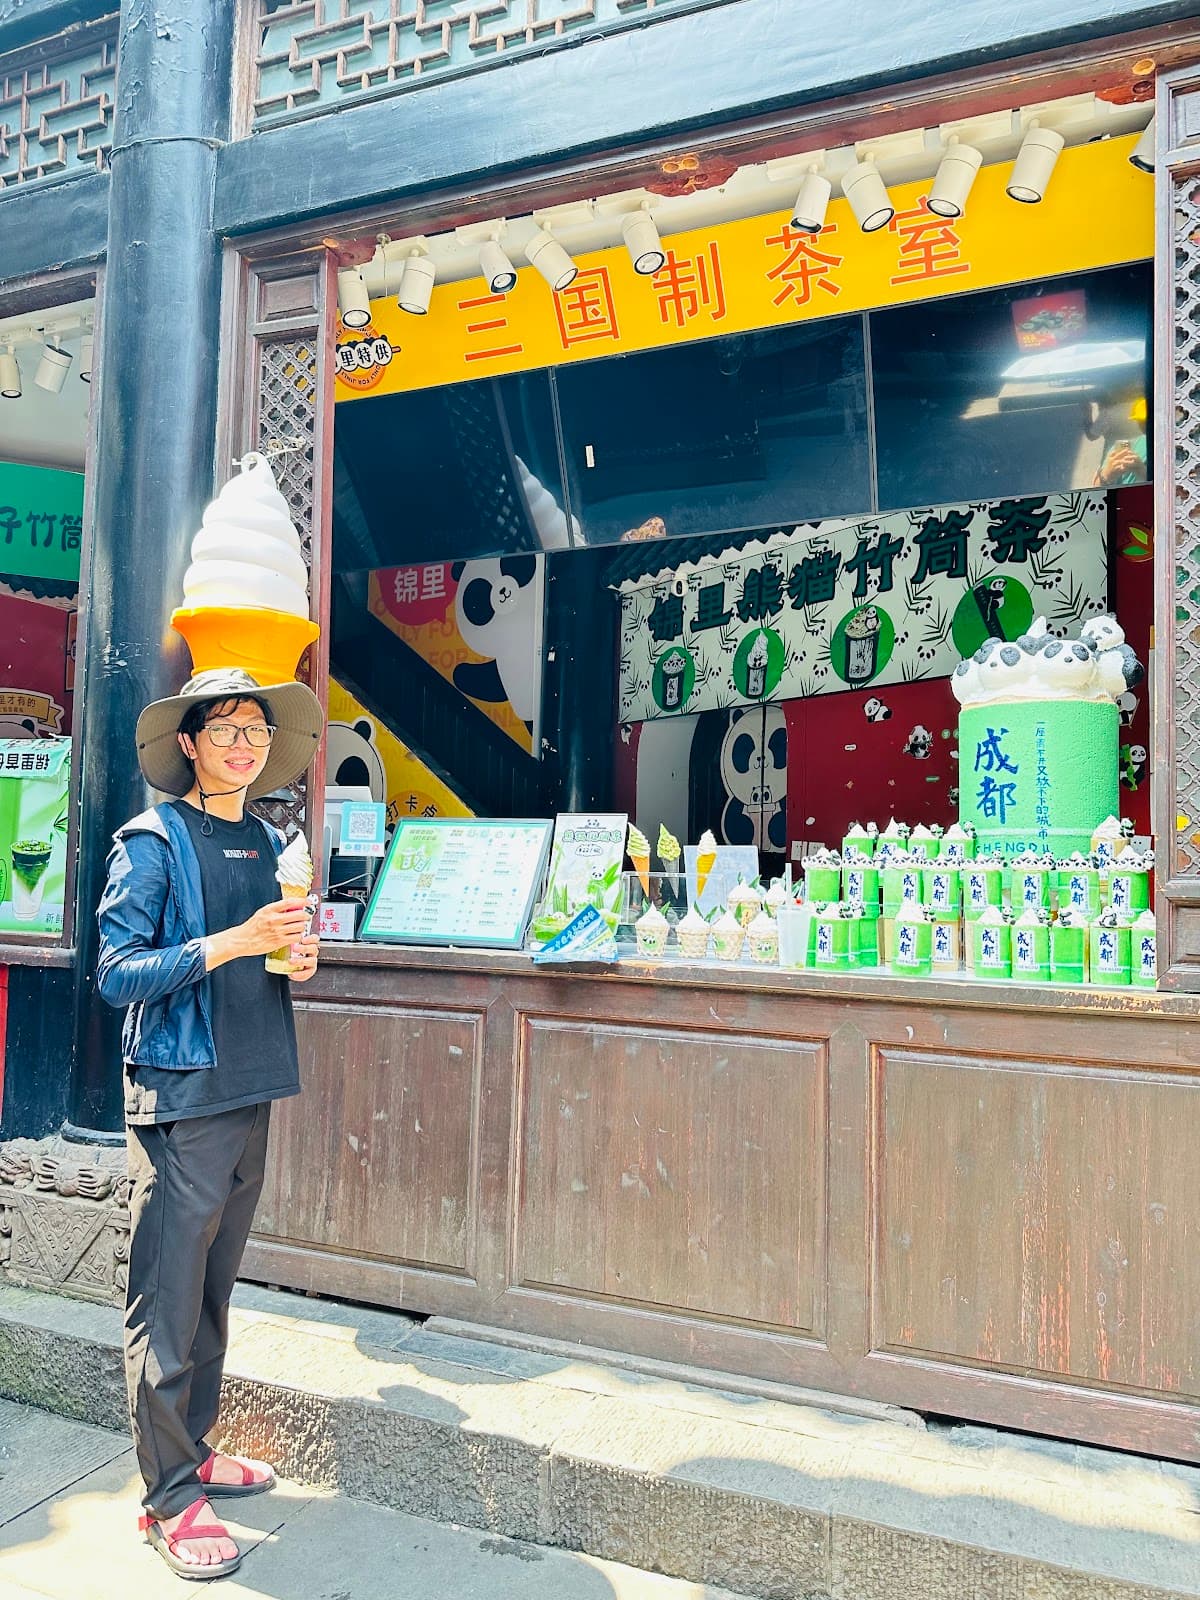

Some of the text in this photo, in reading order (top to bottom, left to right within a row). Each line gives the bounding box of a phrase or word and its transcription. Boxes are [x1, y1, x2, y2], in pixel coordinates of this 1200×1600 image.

[456, 195, 969, 363] 三国制茶室
[335, 344, 390, 368] 里特供
[394, 564, 447, 604] 锦里
[648, 497, 1051, 642] 锦里熊猫竹筒茶
[974, 728, 1018, 824] 成都
[903, 873, 914, 900] 成都
[933, 875, 945, 902] 成都
[970, 875, 982, 902] 成都
[1024, 875, 1037, 903] 成都
[1071, 876, 1084, 905] 成都
[1112, 878, 1125, 906] 成都
[818, 925, 828, 952] 成都
[900, 926, 912, 956] 成都
[936, 926, 948, 952] 成都
[982, 929, 995, 958] 成都
[1017, 931, 1029, 960] 成都
[1099, 932, 1113, 963] 成都
[1141, 937, 1155, 968] 成都
